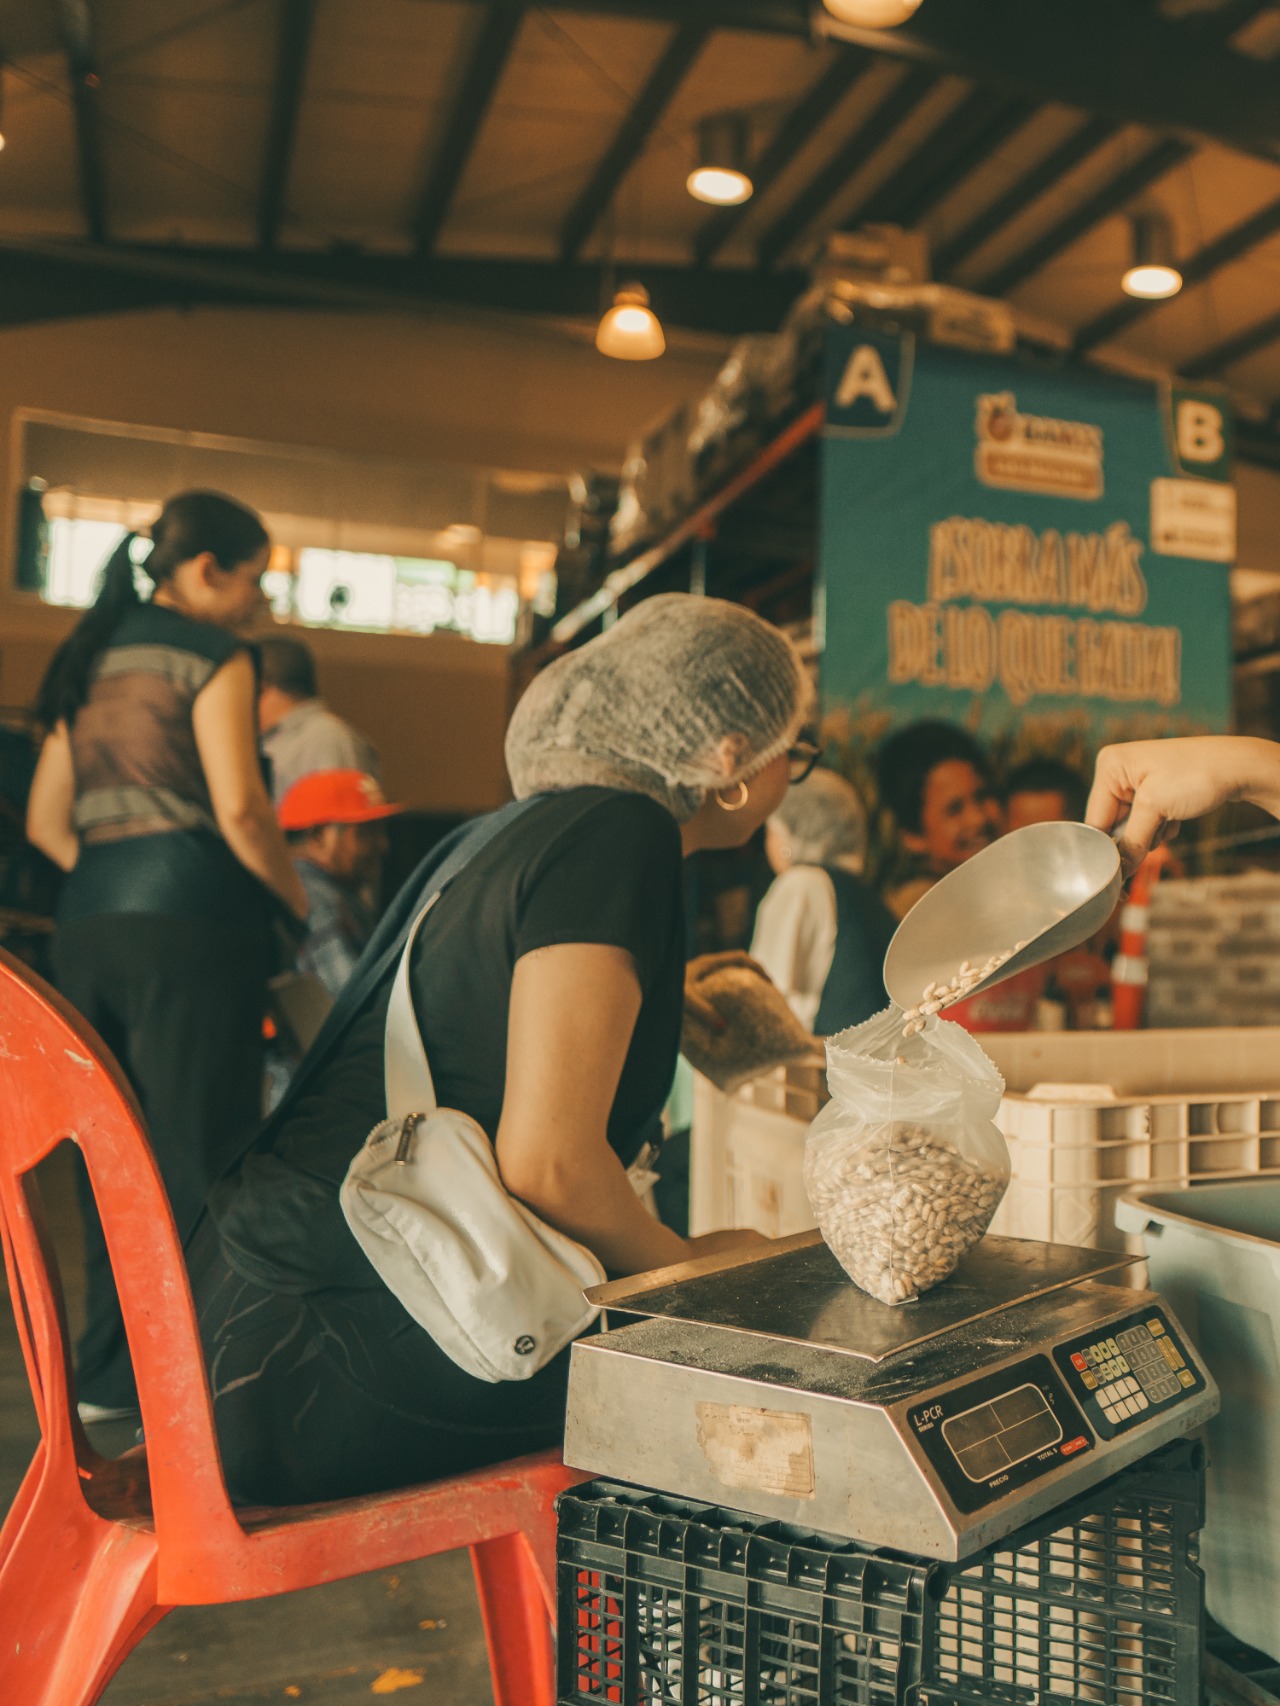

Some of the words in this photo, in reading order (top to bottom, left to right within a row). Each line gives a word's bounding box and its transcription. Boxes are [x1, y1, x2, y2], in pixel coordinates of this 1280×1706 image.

[836, 344, 897, 411] A
[1177, 400, 1225, 462] B
[913, 1404, 944, 1427] L-PCR
[1037, 1450, 1054, 1461] TOTAL
[988, 1474, 1009, 1488] PRECIO
